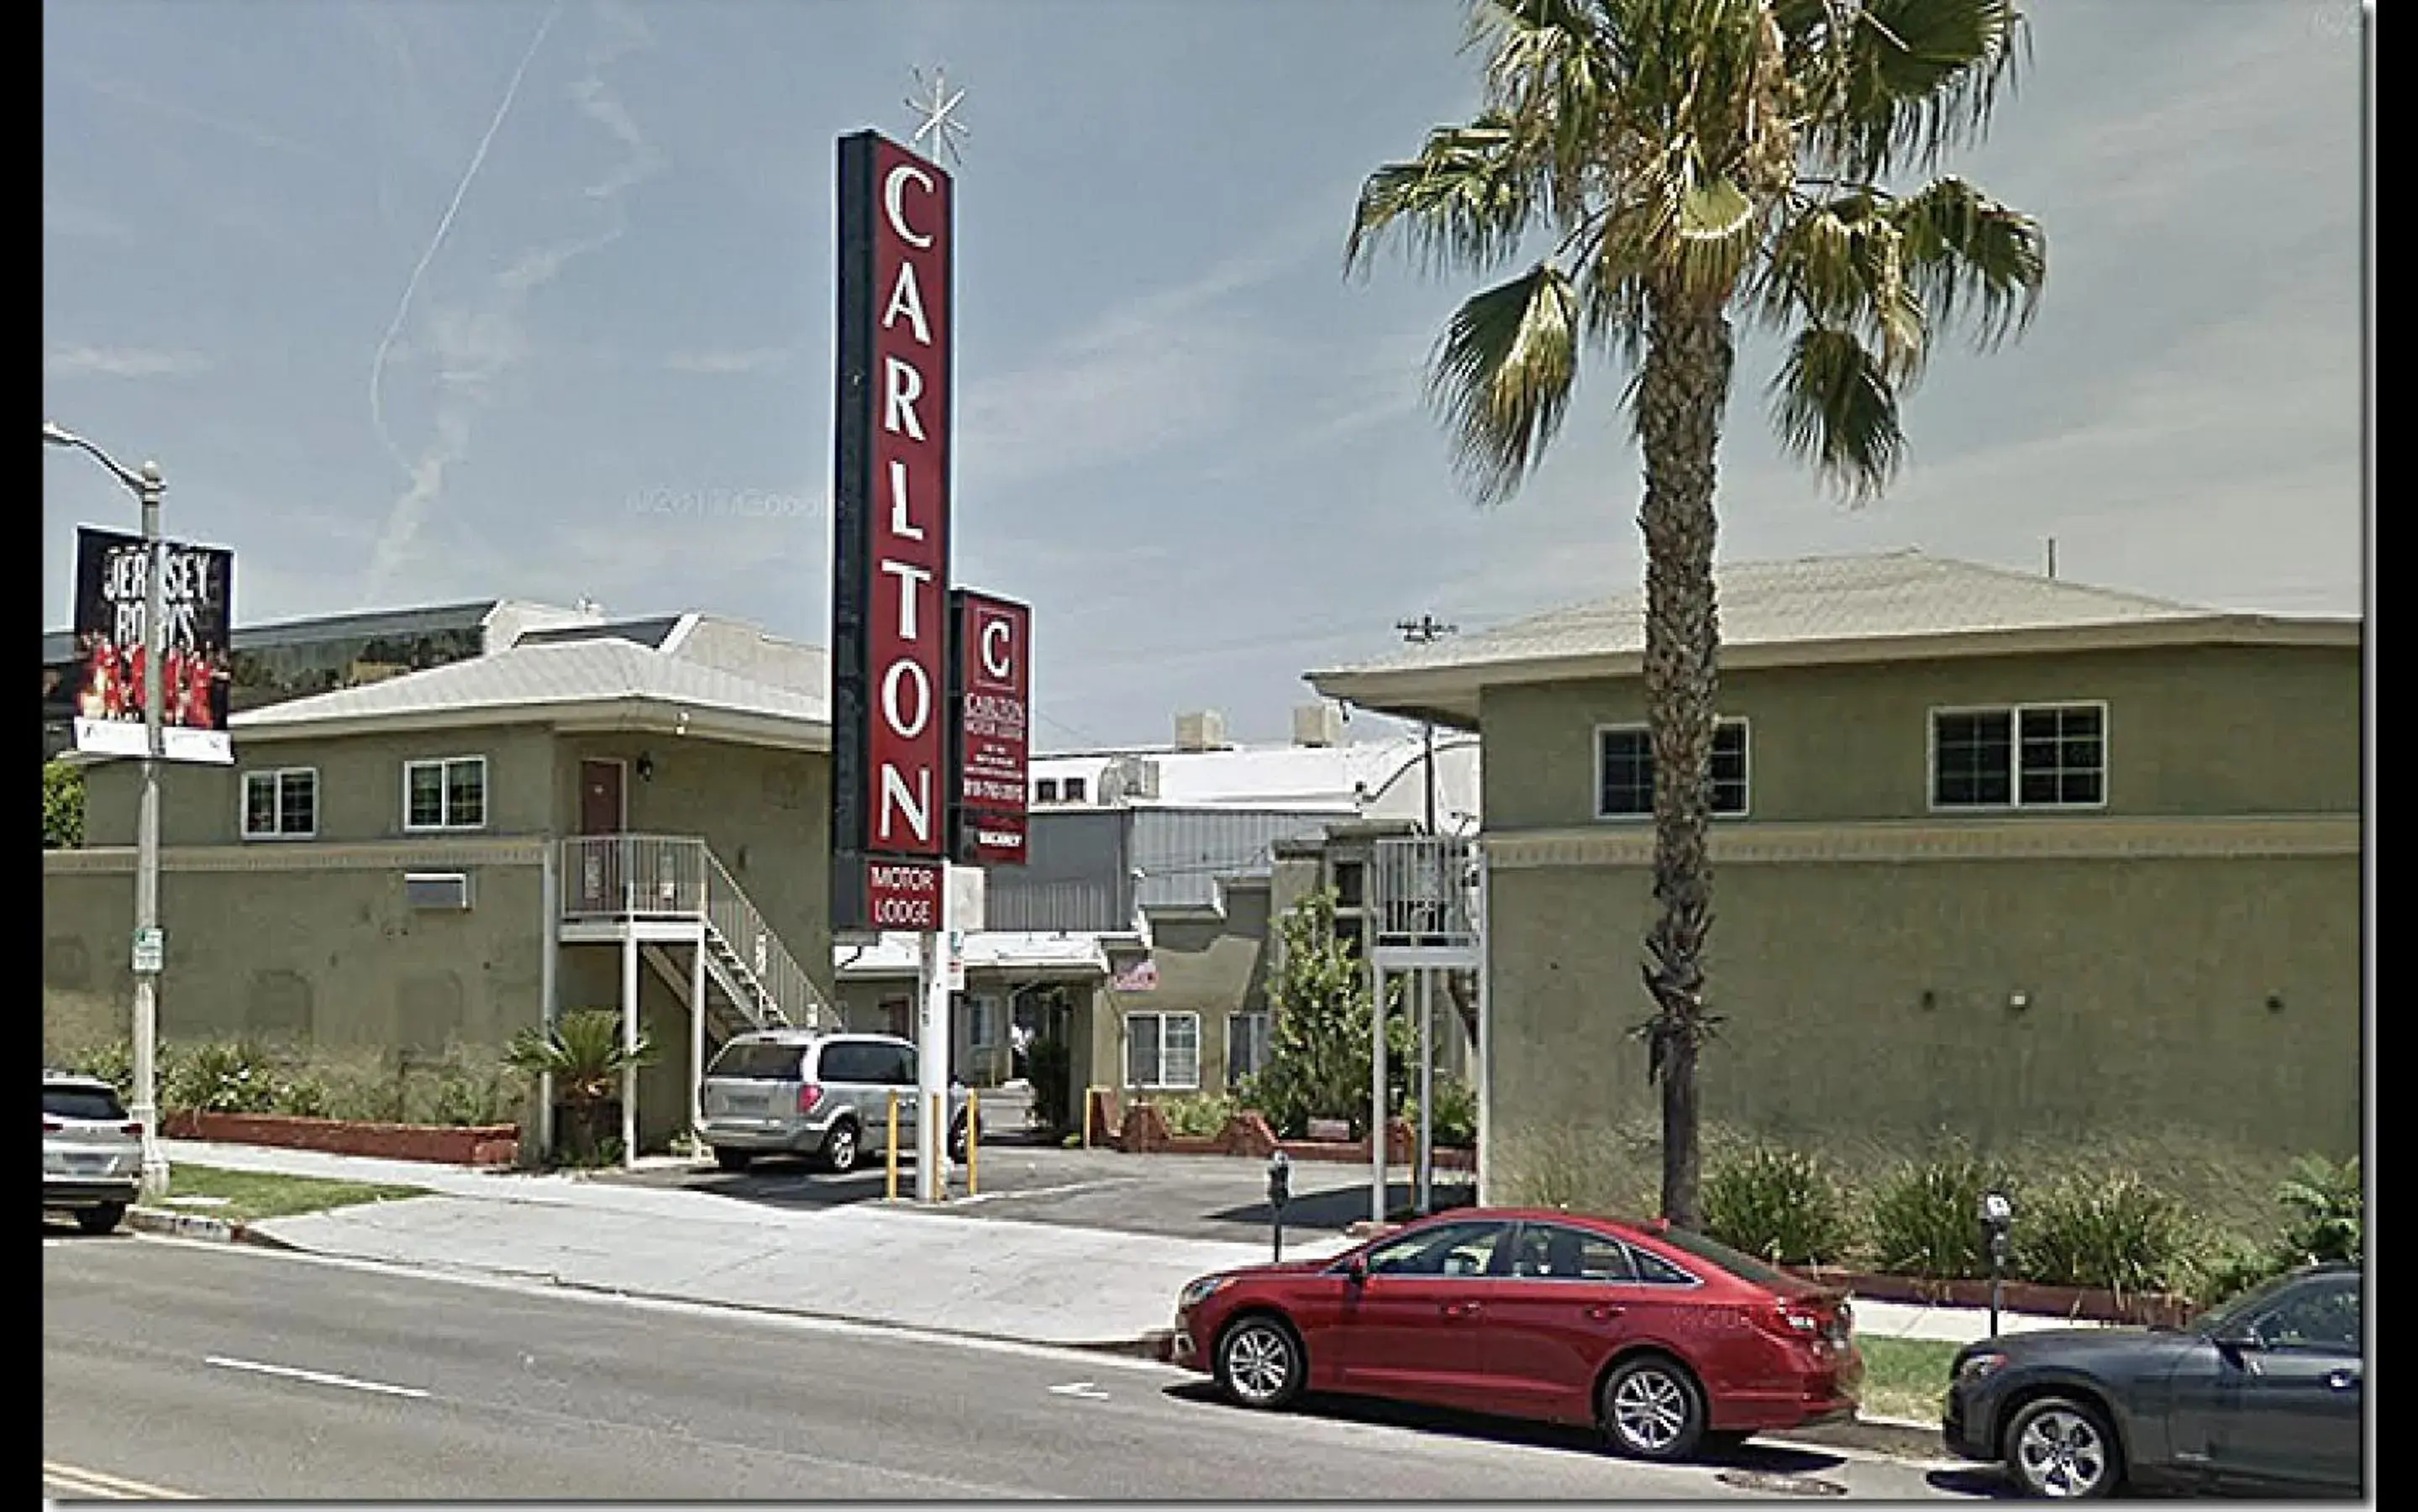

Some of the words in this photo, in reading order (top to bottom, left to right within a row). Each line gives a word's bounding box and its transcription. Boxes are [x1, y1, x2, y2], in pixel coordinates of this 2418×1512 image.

[880, 165, 935, 841] CARLTON
[982, 621, 1009, 678] C
[871, 866, 934, 891] MOTOR
[875, 900, 930, 924] LODGE
